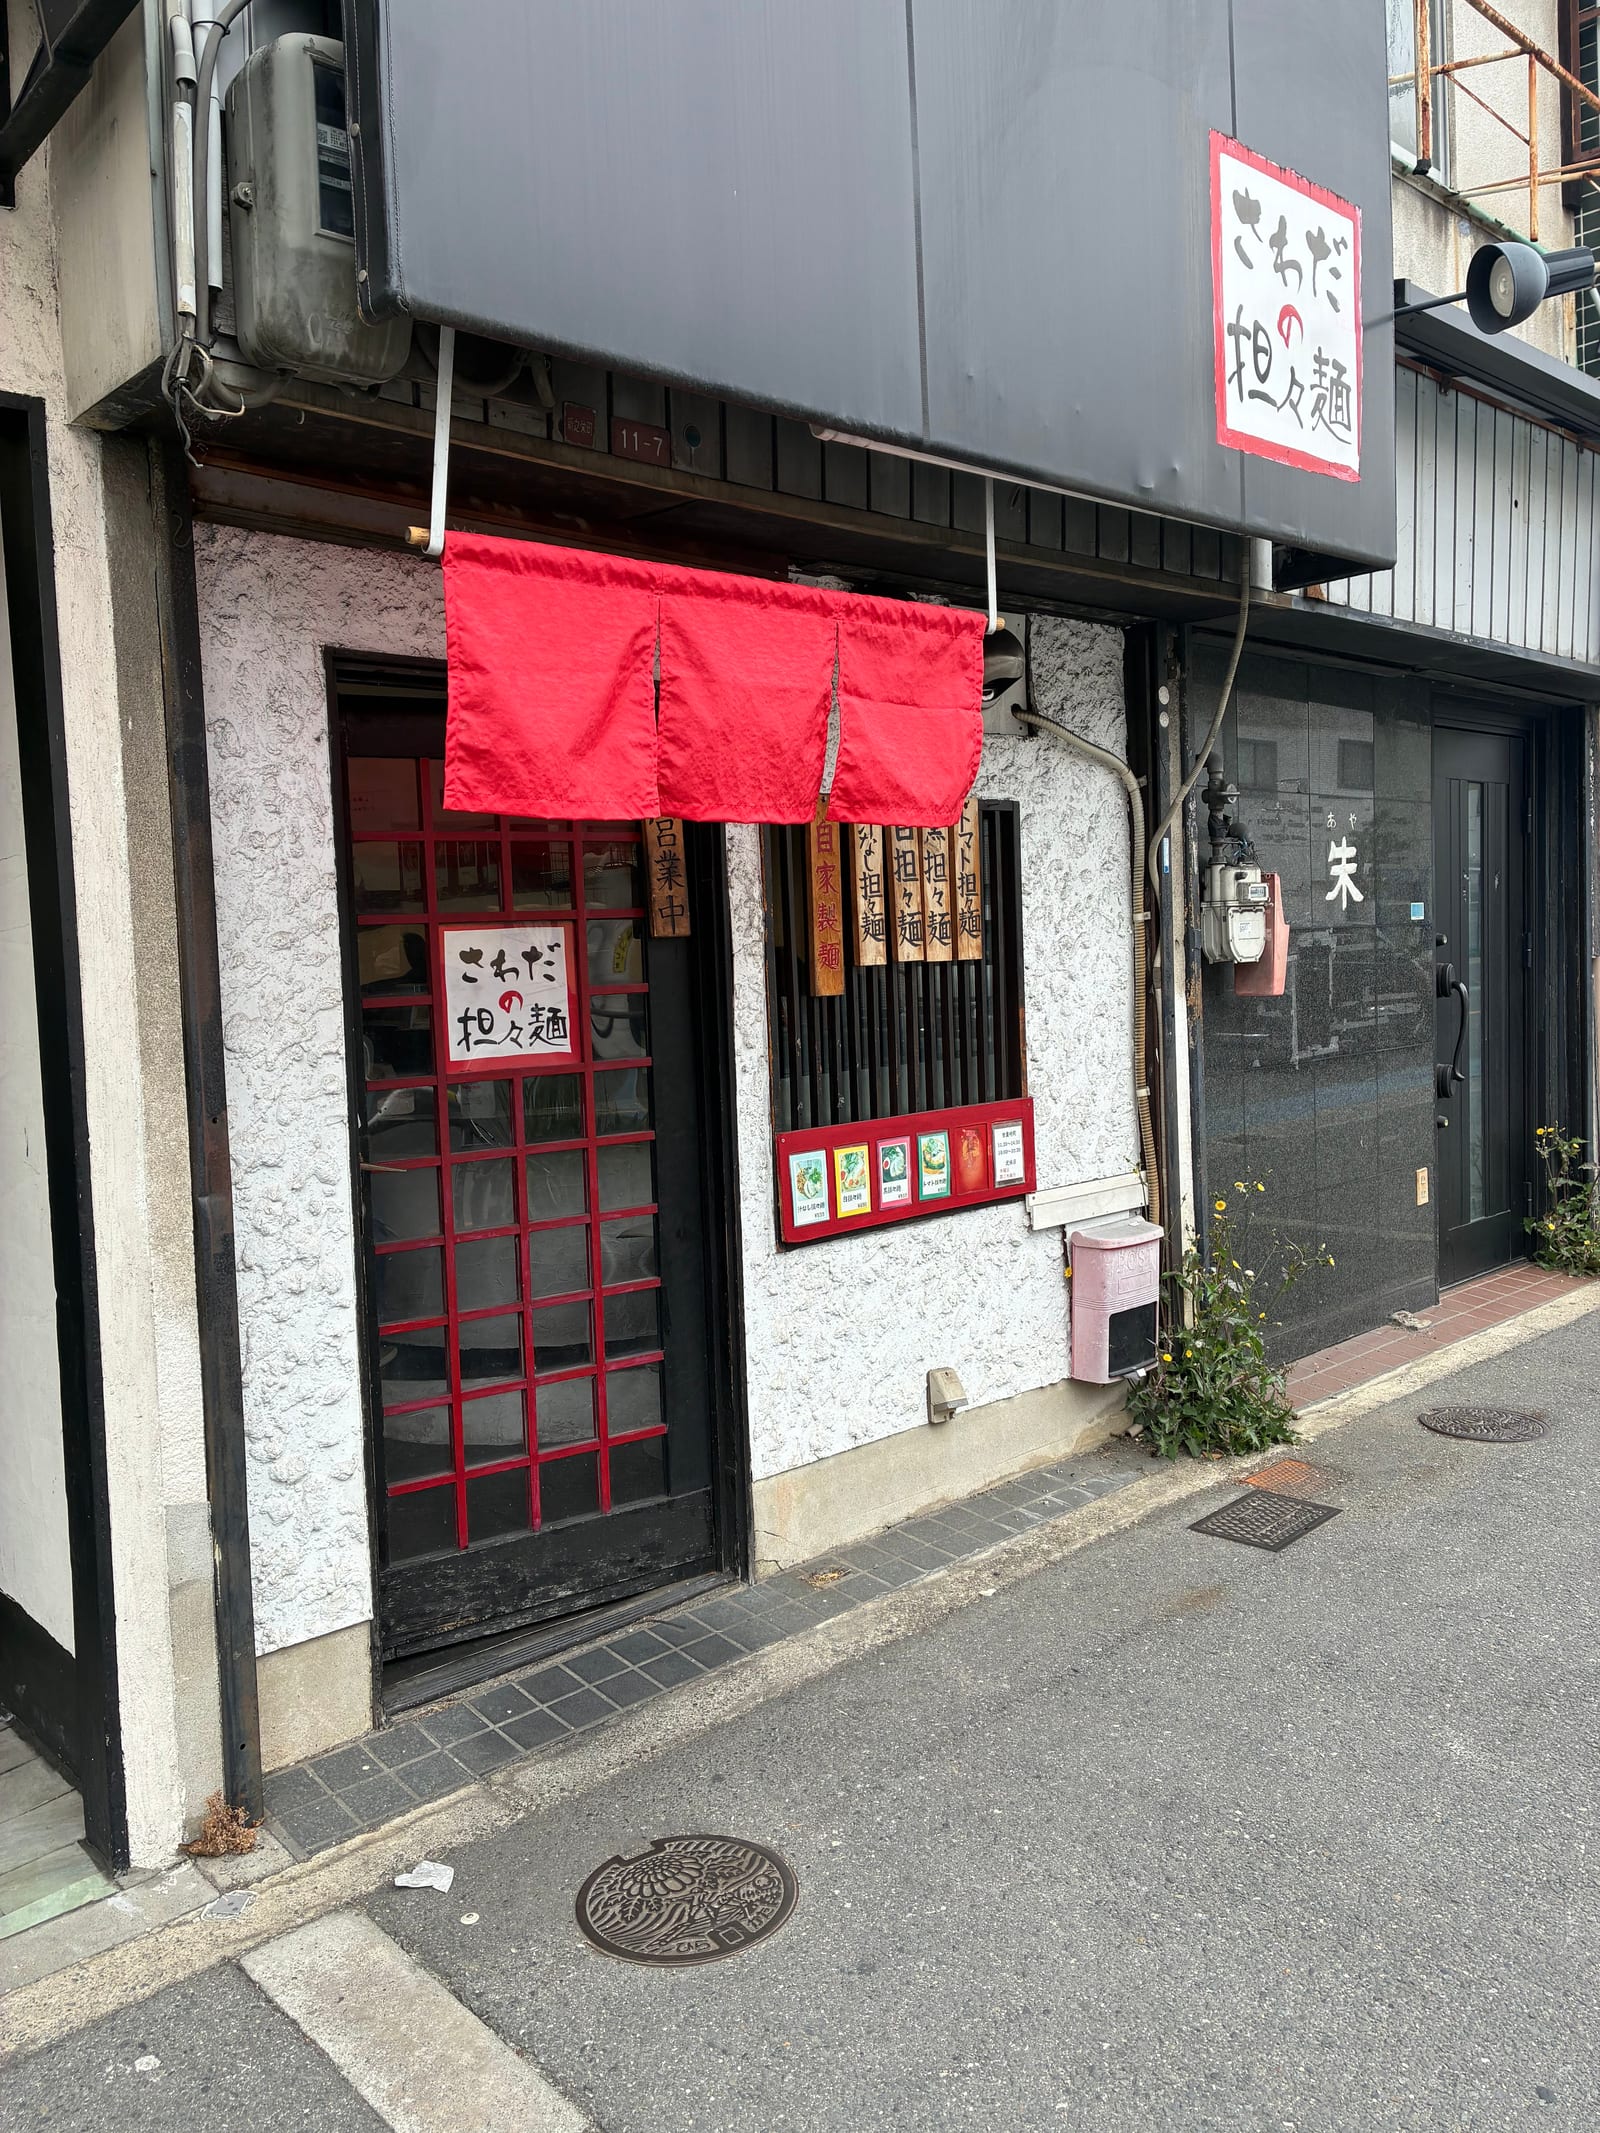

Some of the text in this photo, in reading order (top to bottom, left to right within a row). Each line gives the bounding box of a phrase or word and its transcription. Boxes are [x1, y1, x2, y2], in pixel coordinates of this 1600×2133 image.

[1232, 186, 1349, 313] さわだ
[1277, 303, 1304, 349] の
[1227, 304, 1352, 445] 担々麺
[621, 428, 663, 457] 11-7
[1327, 811, 1357, 830] あや
[815, 820, 840, 971] 自家製麺
[958, 814, 982, 939] トマト担々麺
[1325, 835, 1364, 911] 朱
[459, 942, 561, 984] さわだ
[498, 990, 524, 1014] の
[457, 1003, 569, 1052] 担々麺
